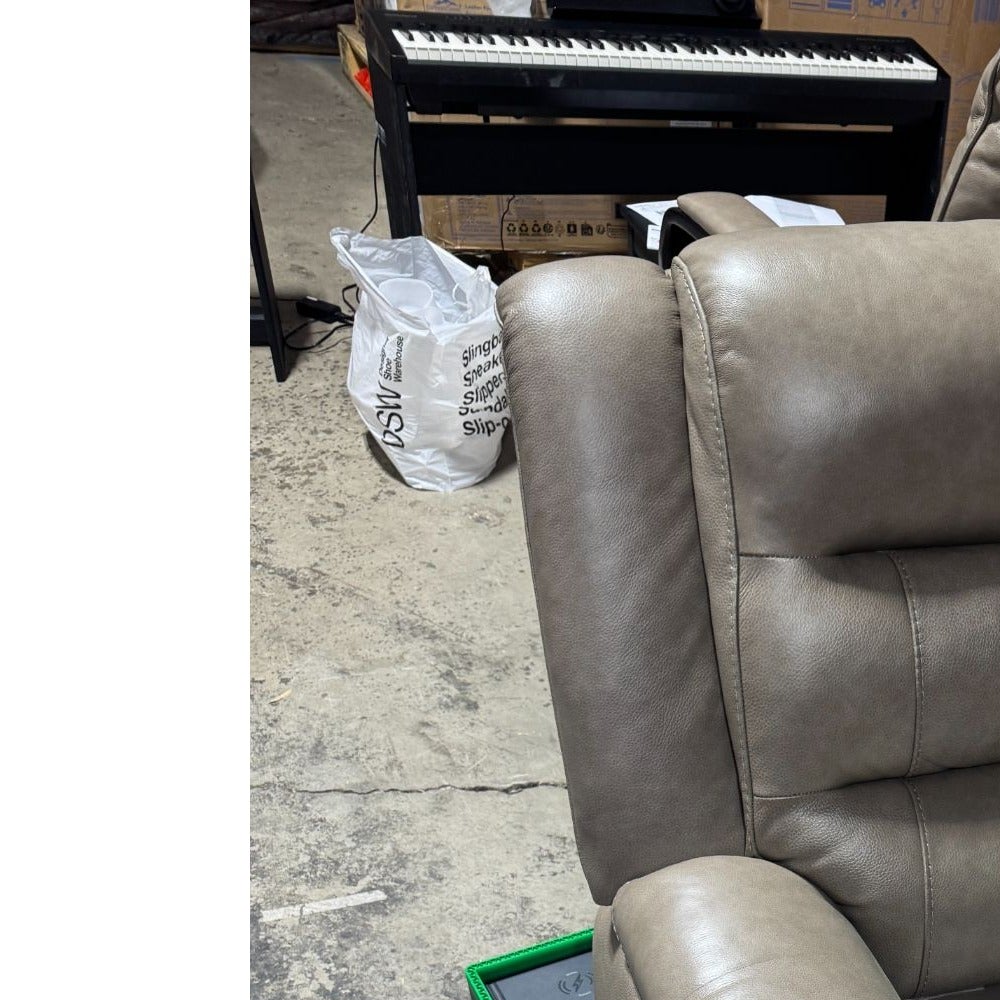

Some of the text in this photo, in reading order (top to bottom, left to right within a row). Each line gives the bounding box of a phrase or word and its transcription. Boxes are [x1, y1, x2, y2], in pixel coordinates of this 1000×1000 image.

[393, 335, 404, 382] Warehouse
[462, 333, 502, 367] Slingb
[384, 358, 393, 381] Shoe
[464, 353, 502, 387] Sneak
[463, 372, 506, 405] Slipper
[375, 380, 404, 448] DSW
